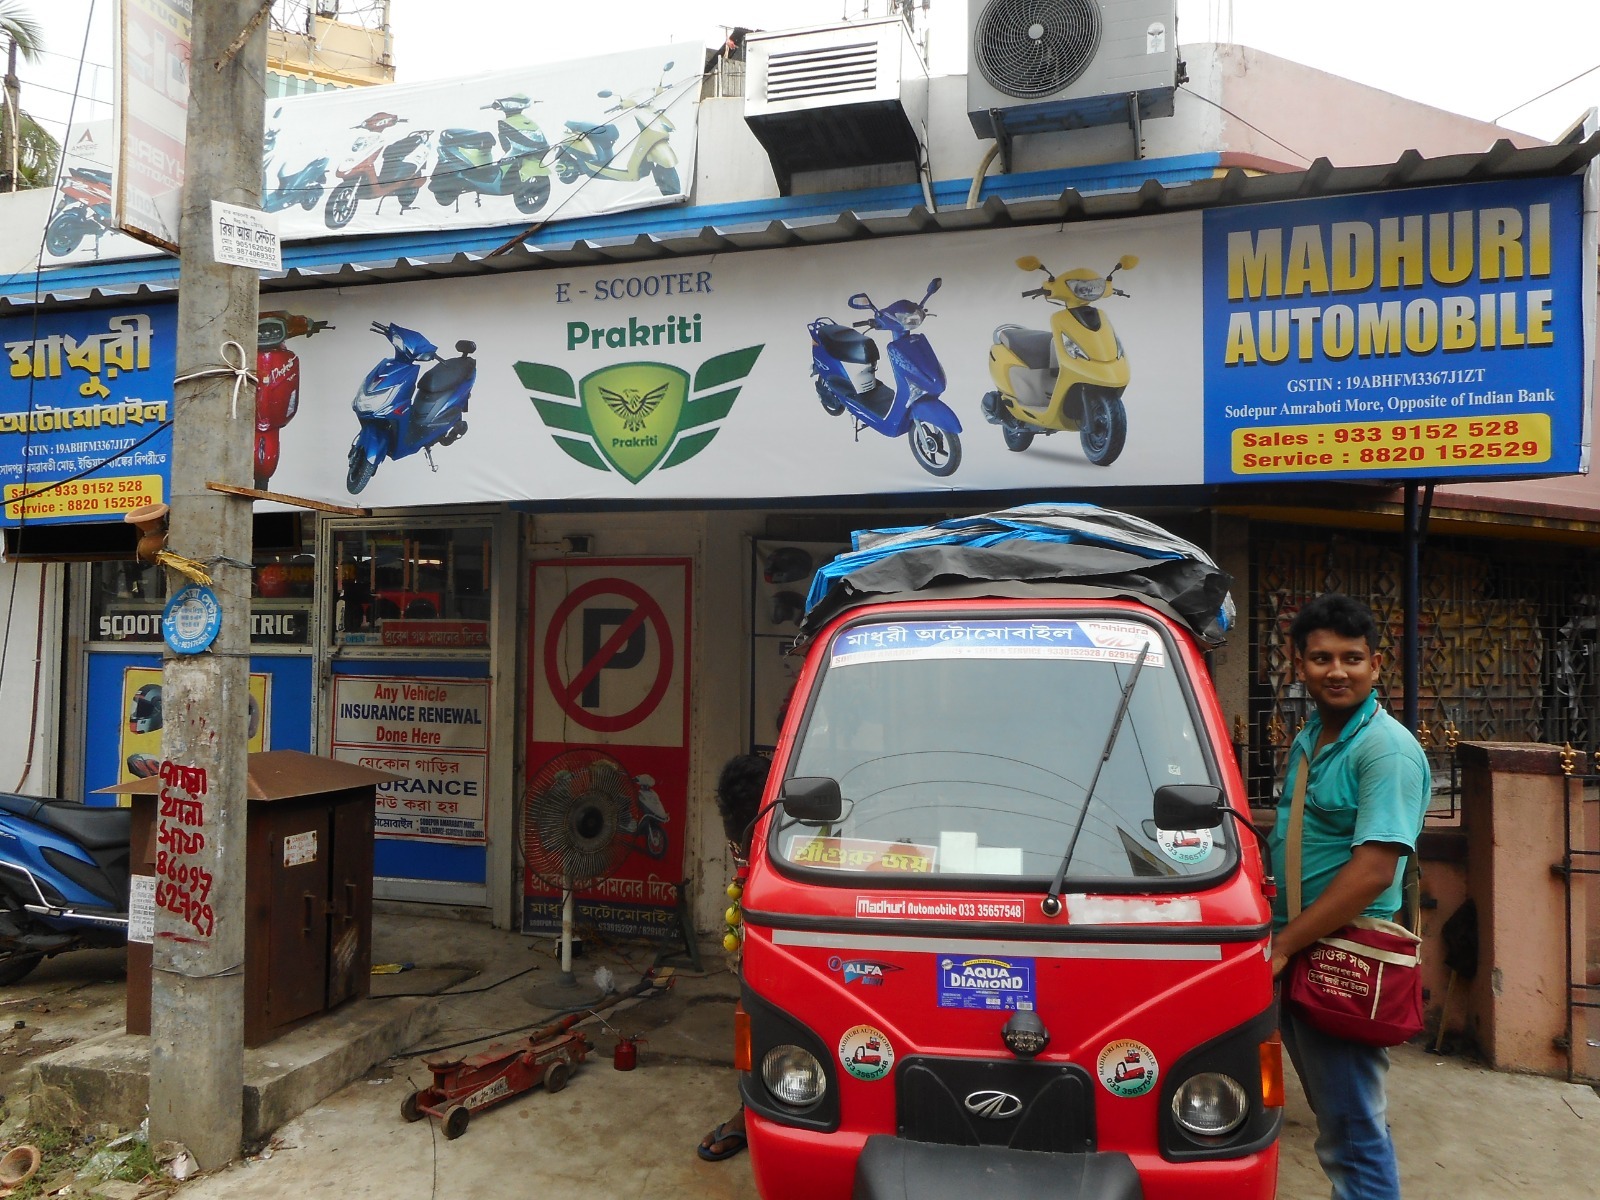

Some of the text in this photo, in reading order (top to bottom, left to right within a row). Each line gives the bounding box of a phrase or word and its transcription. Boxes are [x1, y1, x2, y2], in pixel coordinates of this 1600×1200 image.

[235, 240, 276, 254] 9051620507
[236, 247, 276, 261] 9874069352
[1226, 202, 1552, 300] MADHURI
[554, 282, 571, 304] E
[593, 270, 715, 301] SCOOTER
[566, 312, 702, 351] Prakriti
[1224, 288, 1554, 366] AUTOMOBILE
[5, 313, 154, 399] মাধুরী
[1286, 377, 1333, 393] GSTIN
[1345, 367, 1486, 391] 19ABHFM3367J1ZT
[0, 396, 169, 433] অটোমোবাইল
[1224, 387, 1555, 421] Sodepur Amraboti More, Opposite of Indian Bank
[611, 434, 658, 449] Prakriti
[1242, 430, 1309, 449] Sales
[1333, 426, 1383, 445] 933
[1391, 423, 1458, 441] 9152
[1468, 420, 1519, 438] 528
[22, 444, 49, 457] GSTIN
[1242, 451, 1334, 470] Service
[1358, 445, 1426, 464] 8820
[1435, 440, 1538, 461] 152529
[11, 487, 43, 499] Sales
[54, 484, 78, 497] 933
[82, 482, 114, 495] 9152
[118, 480, 143, 493] 528
[12, 501, 56, 515] Service
[67, 498, 99, 511] 8820
[104, 495, 152, 509] 152529
[100, 614, 163, 636] SCOOT
[249, 614, 294, 636] TRIC
[846, 623, 1073, 647] মাধুরী অটোমোবাইল
[1088, 623, 1149, 636] mahindra
[374, 683, 447, 704] Any Vehicle
[340, 703, 482, 725] INSURANCE RENEWAL
[376, 726, 441, 744] Done Here
[415, 757, 460, 775] গাড়ির
[376, 779, 478, 797] URANCE
[402, 799, 431, 812] করা
[436, 801, 459, 814] হয়
[1165, 842, 1178, 856] 033
[858, 899, 1021, 918] Madhuri Automobile 033 35657548
[845, 963, 883, 976] ALFA
[963, 966, 1010, 979] AQUA
[950, 972, 1023, 989] DIAMOND
[840, 1028, 893, 1058] MADHURI AUTOMOBILE
[844, 1056, 889, 1079] 033 35657548
[1099, 1042, 1157, 1076] MADHURI AUTOMOBILE
[1106, 1069, 1154, 1095] 033 35657548
